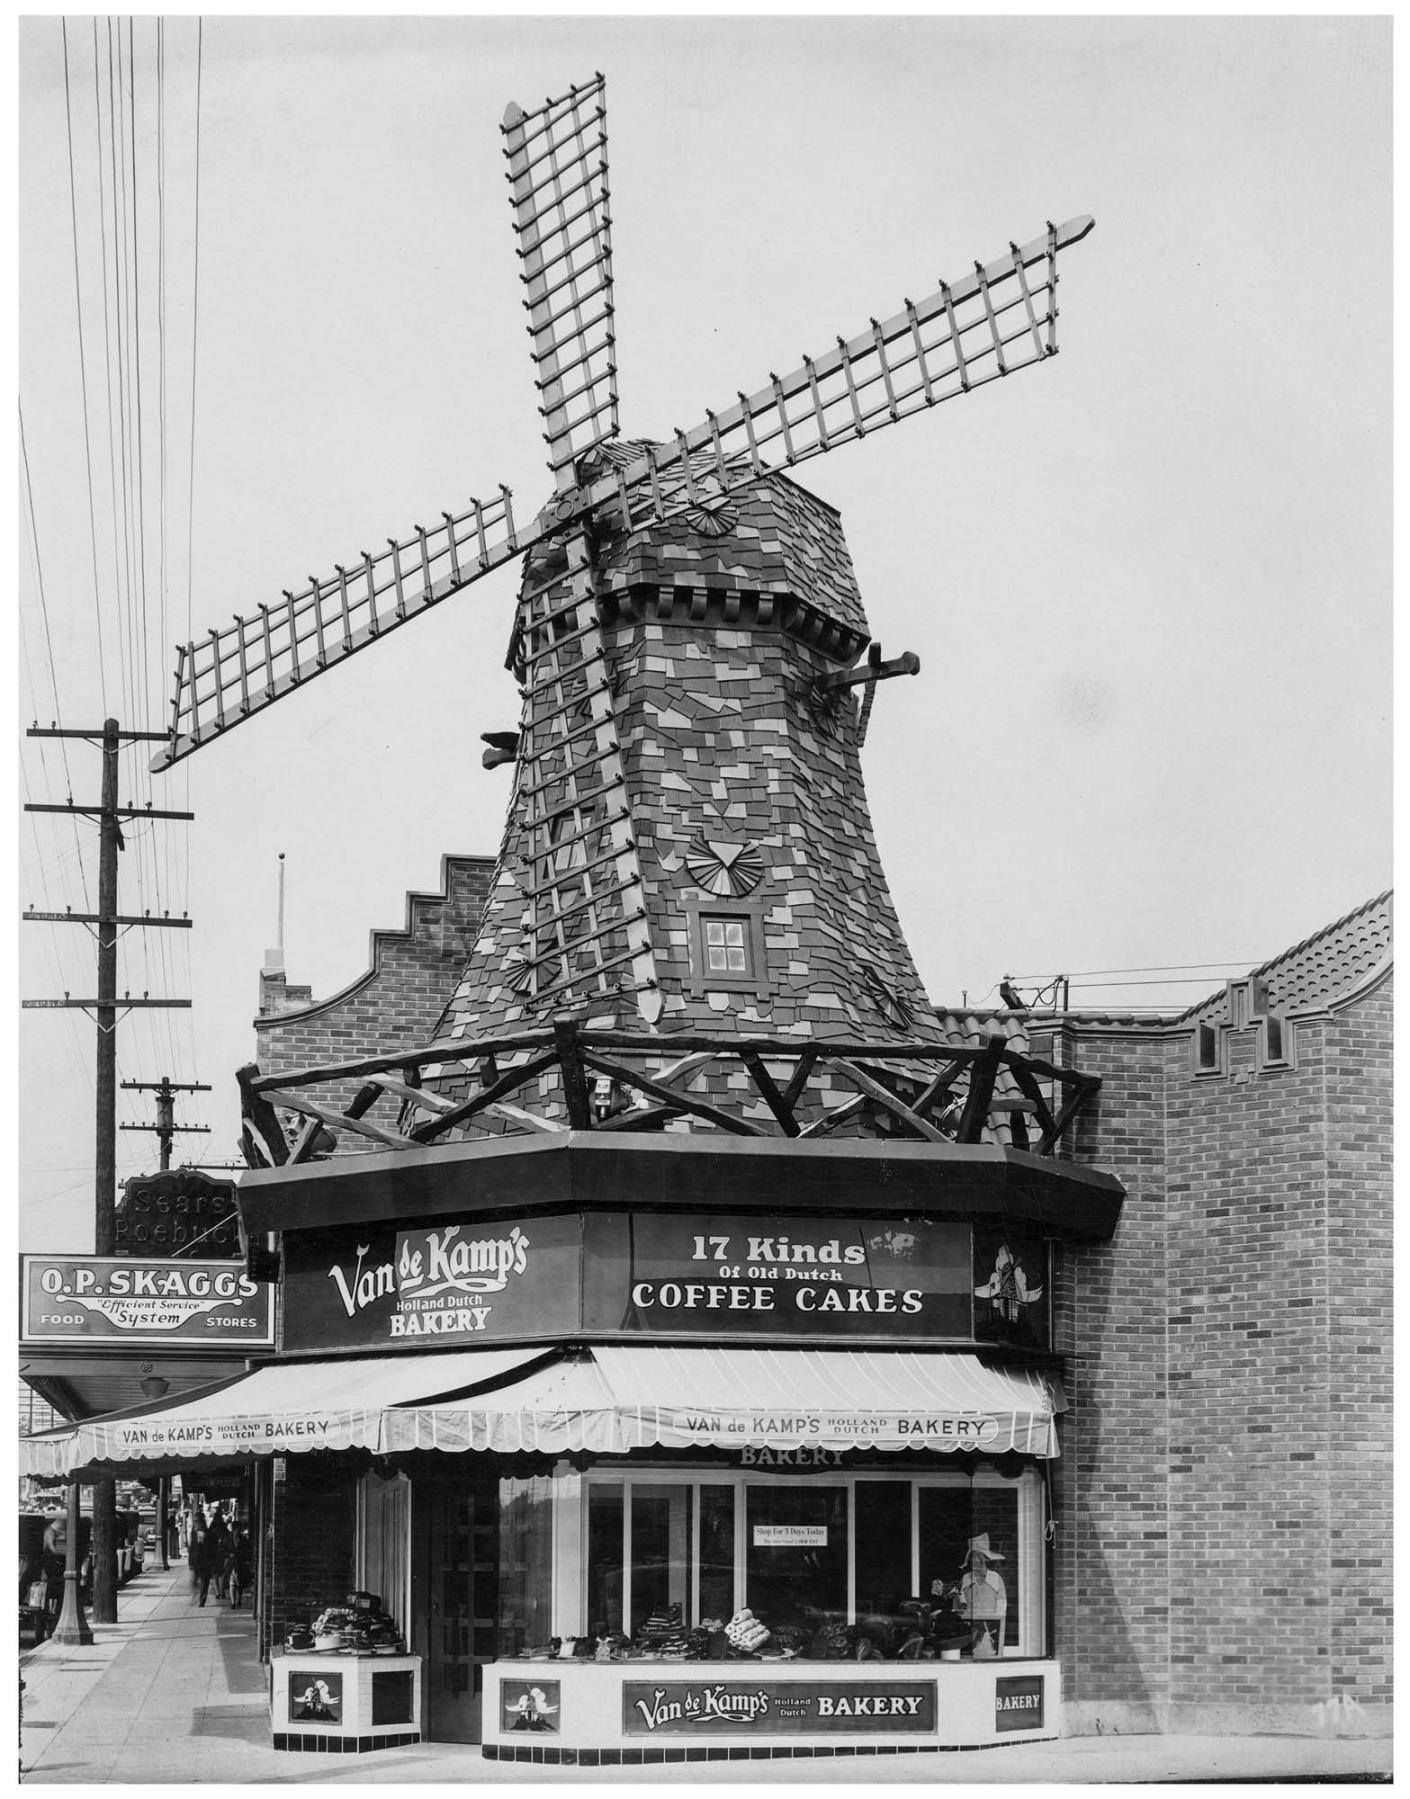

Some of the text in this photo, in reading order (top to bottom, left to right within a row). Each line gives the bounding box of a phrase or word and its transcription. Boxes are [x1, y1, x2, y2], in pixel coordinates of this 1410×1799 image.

[135, 1189, 226, 1214] Sears
[692, 1235, 866, 1265] 17 Kinds
[328, 1225, 530, 1318] Van de Kamp's
[719, 1266, 843, 1282] Of Old Dutch
[109, 1269, 259, 1298] SKAGGS
[396, 1294, 483, 1312] Holland Dutch
[632, 1283, 924, 1314] COFFEE CAKES
[40, 1315, 85, 1325] FOOD
[118, 1311, 180, 1327] System
[206, 1317, 257, 1328] STORES
[389, 1306, 492, 1338] BAKERY
[217, 1424, 261, 1432] HOLLAND
[265, 1420, 329, 1437] BAKERY
[686, 1415, 821, 1433] VAN de KAMP'S
[828, 1418, 887, 1427] HOLLAND
[834, 1426, 880, 1434] DUTCH
[898, 1419, 986, 1436] BAKERY
[123, 1425, 213, 1443] VAN de KAMP'S
[222, 1431, 255, 1439] DUTCH
[740, 1446, 846, 1465] BAKERY
[806, 1527, 825, 1536] Today
[636, 1685, 769, 1730] Van de Kamp's
[774, 1697, 811, 1706] Holland
[817, 1696, 925, 1716] BAKERY
[996, 1694, 1041, 1711] BAKERY
[780, 1709, 806, 1717] Dutch
